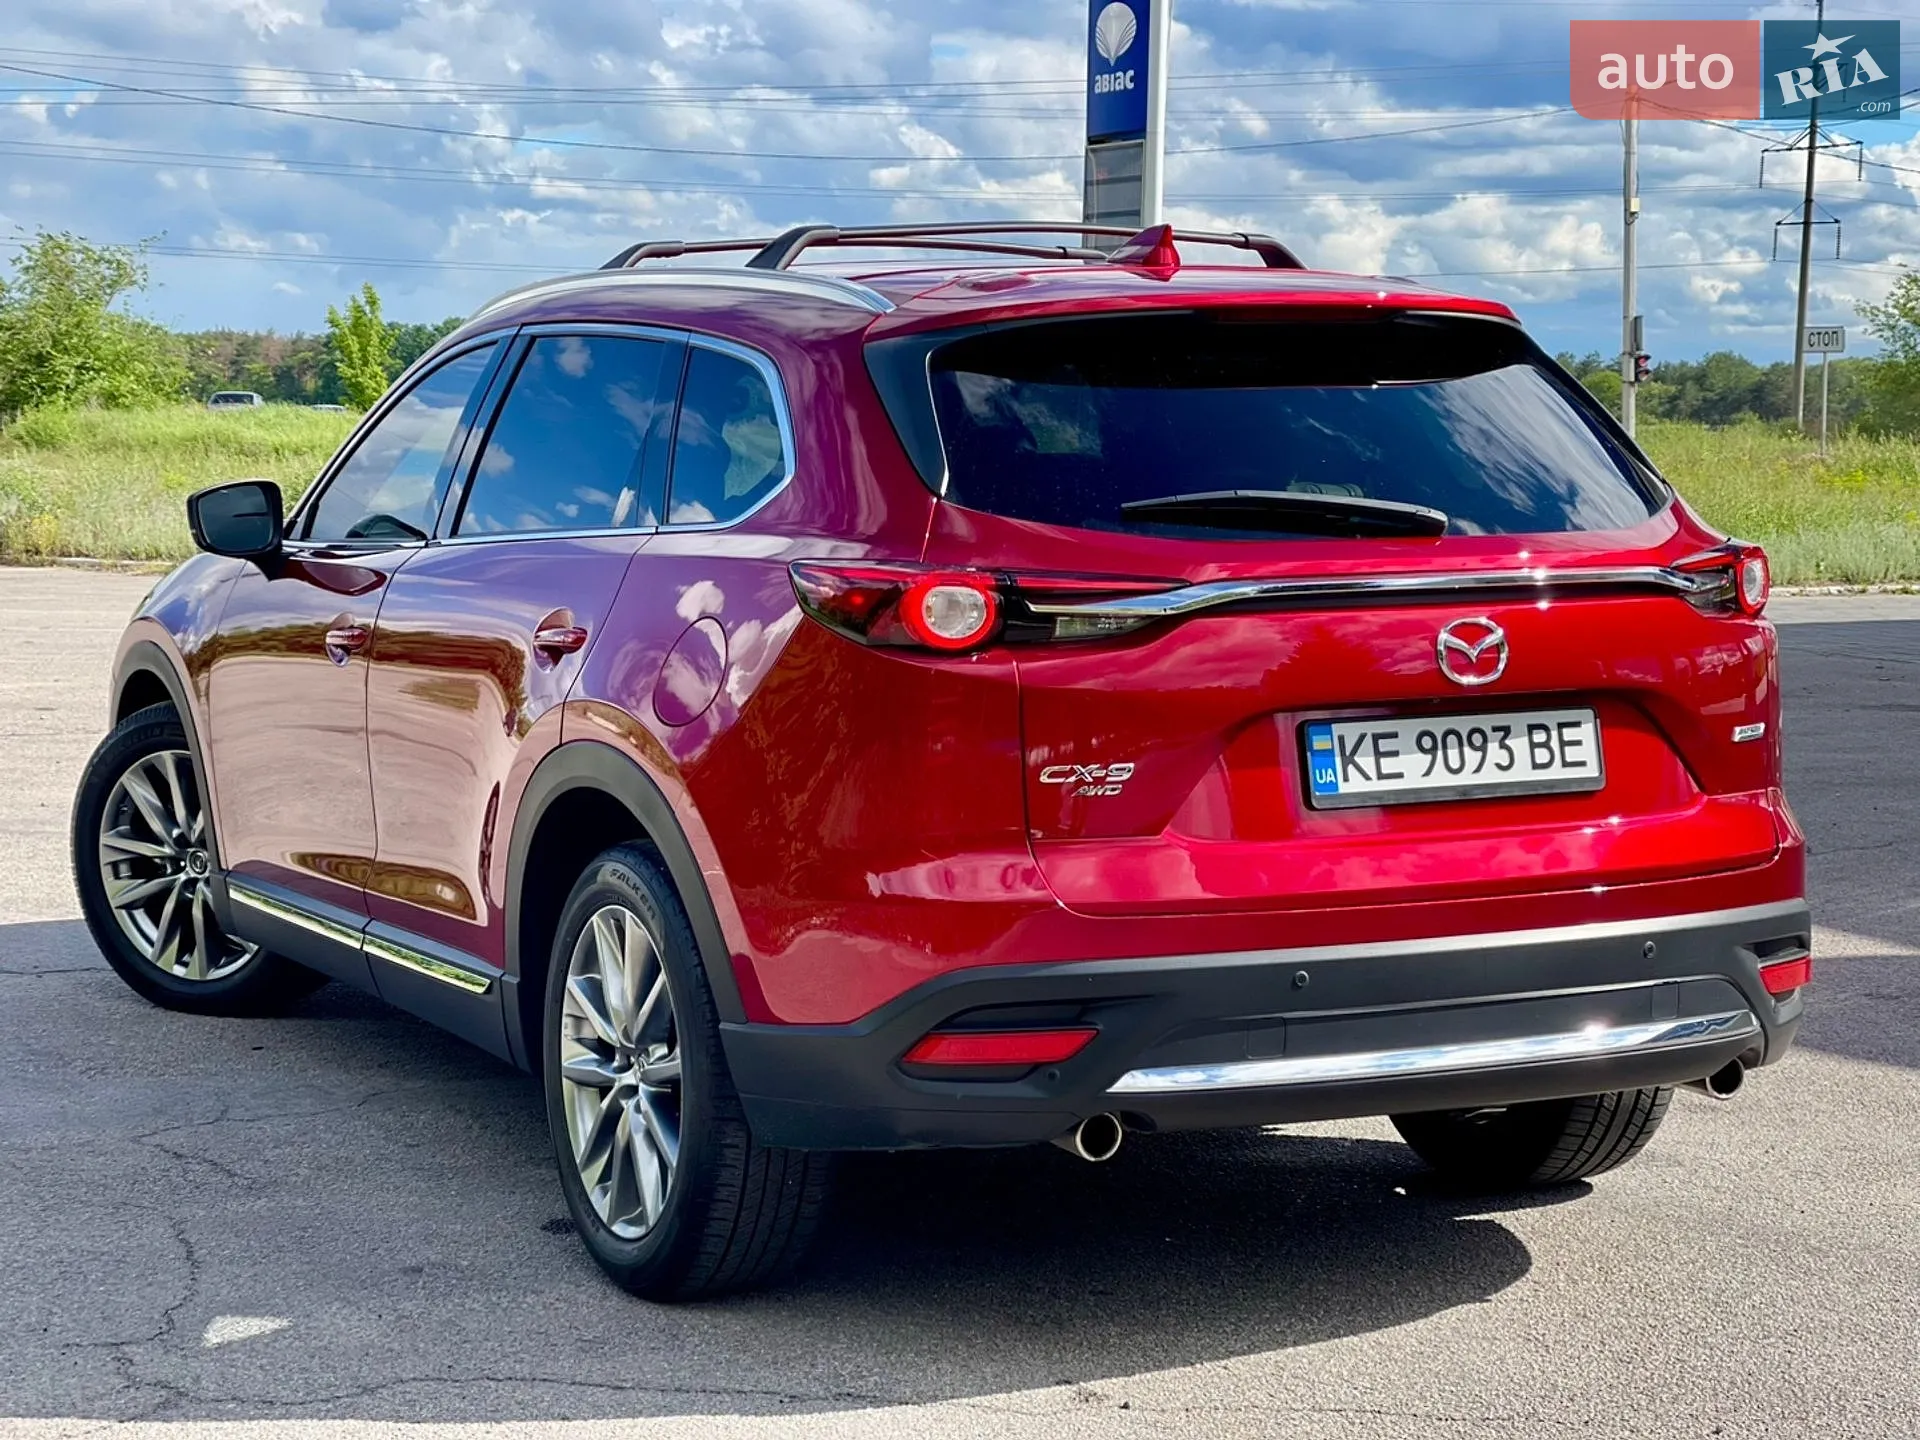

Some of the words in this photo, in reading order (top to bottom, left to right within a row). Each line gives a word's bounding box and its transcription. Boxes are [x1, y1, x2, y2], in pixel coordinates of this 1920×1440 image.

[1807, 331, 1840, 348] СТОП
[1337, 730, 1405, 783] KE
[1415, 725, 1516, 778] 9093
[1526, 720, 1588, 771] BE
[1039, 762, 1135, 783] CX-9
[1315, 767, 1336, 784] UA
[1070, 784, 1122, 797] AWD
